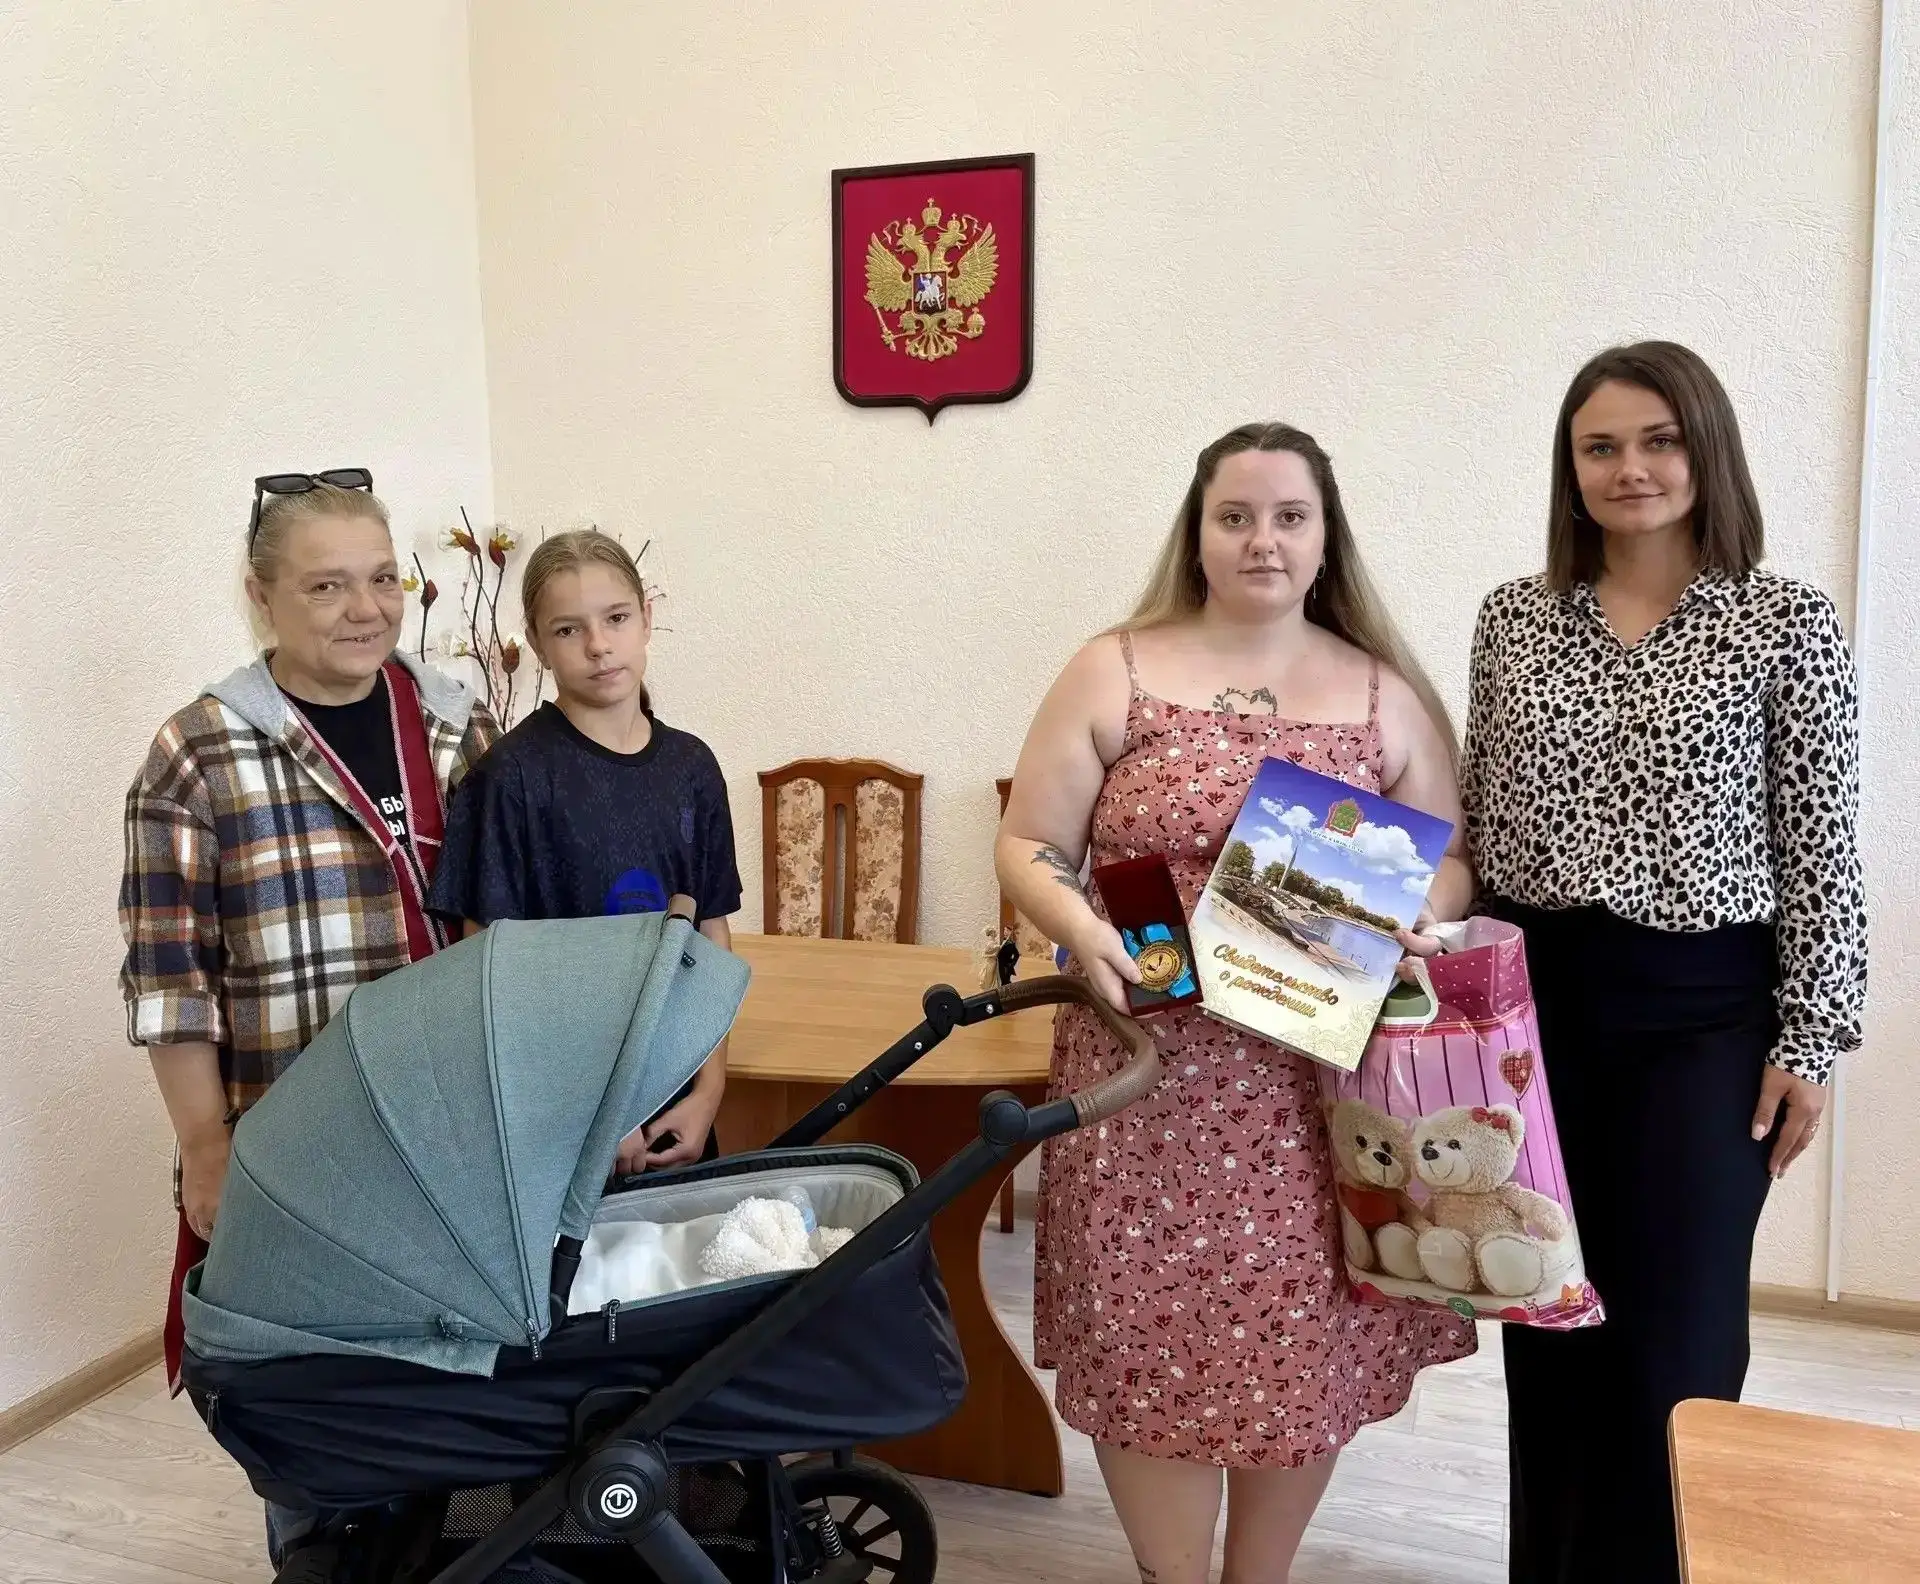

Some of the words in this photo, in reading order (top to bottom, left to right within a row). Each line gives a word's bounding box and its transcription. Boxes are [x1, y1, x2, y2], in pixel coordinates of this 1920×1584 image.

[1213, 943, 1339, 1006] Свидетельство
[1219, 970, 1231, 981] о
[1226, 975, 1317, 1018] рождении
